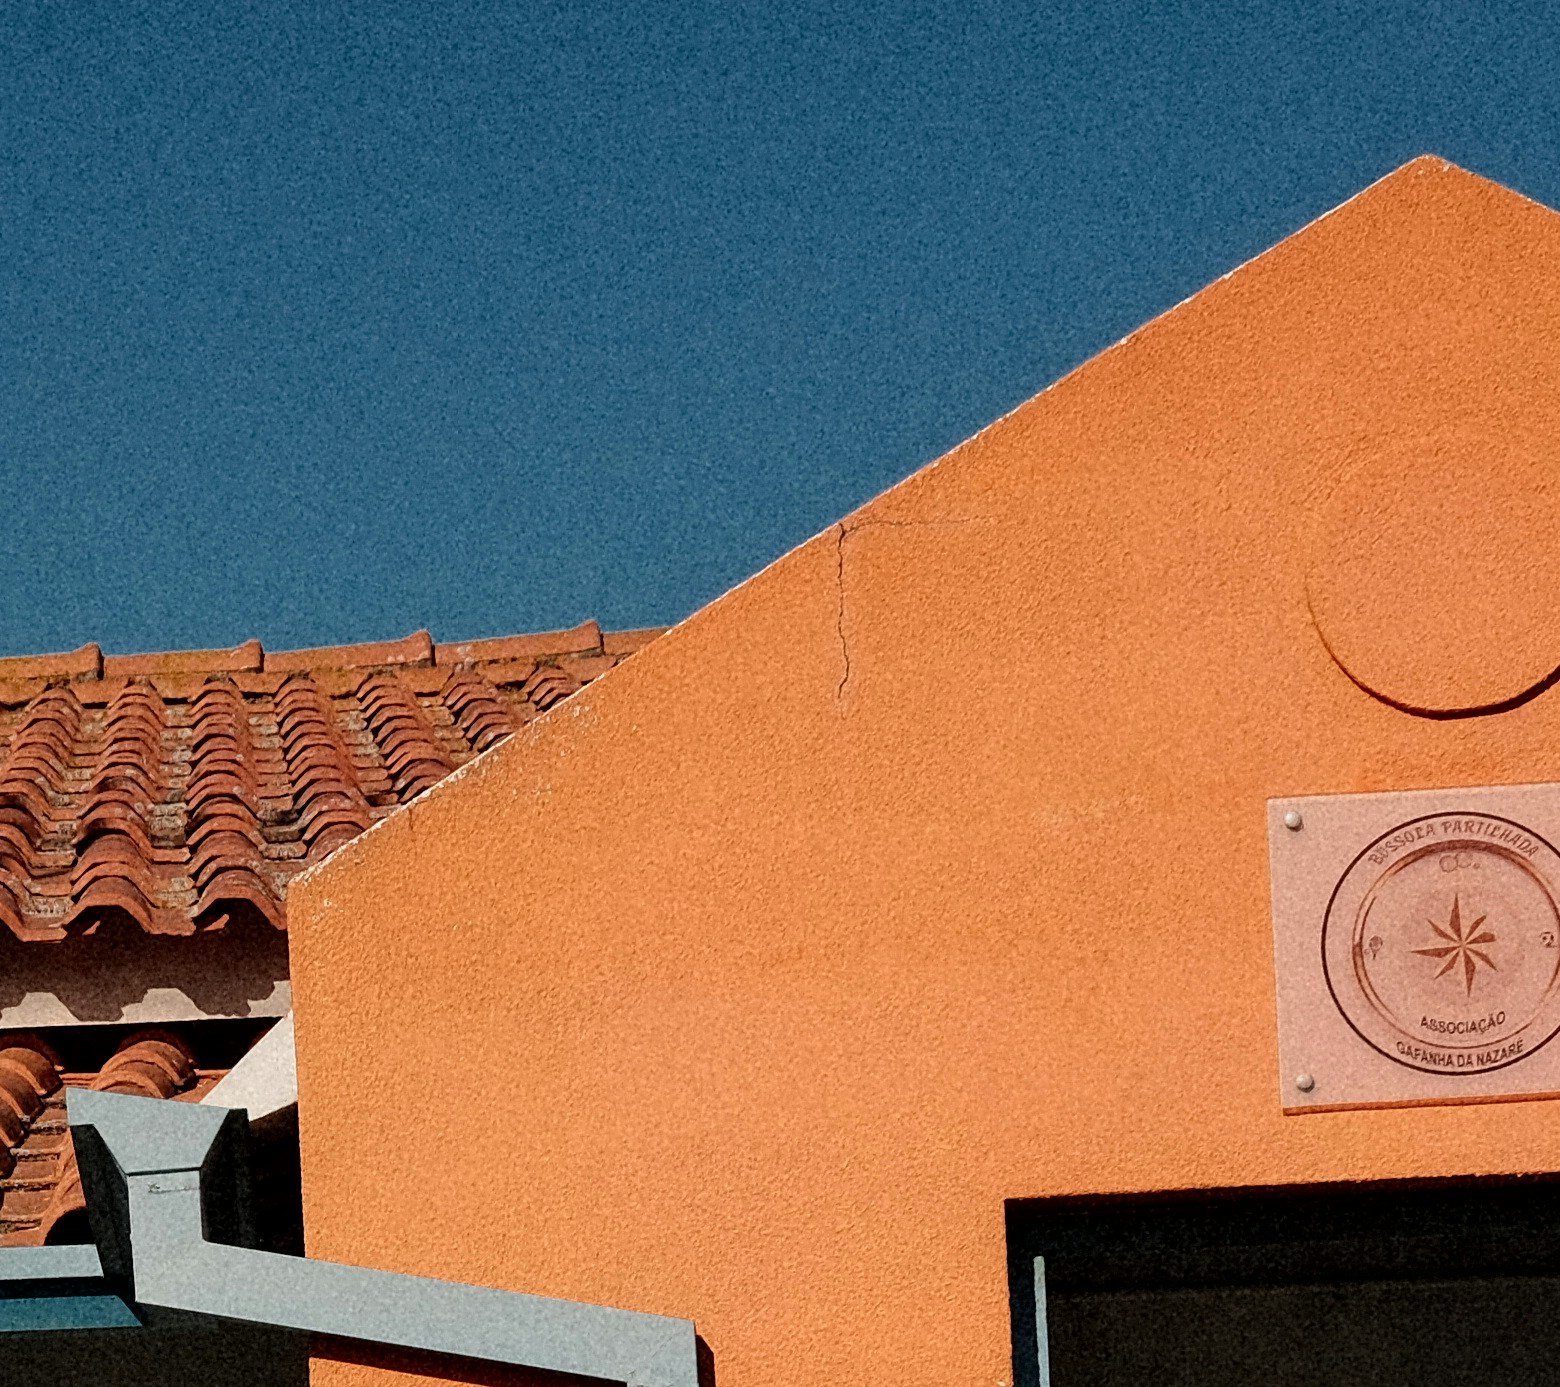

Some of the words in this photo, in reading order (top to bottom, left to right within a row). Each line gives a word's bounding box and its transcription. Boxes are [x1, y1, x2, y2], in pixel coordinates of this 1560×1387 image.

[1441, 819, 1539, 857] PARTILHADA
[1421, 1010, 1506, 1035] ASSOCIAÇÃO
[1396, 1041, 1455, 1067] GAFANHA
[1457, 1054, 1474, 1068] DA
